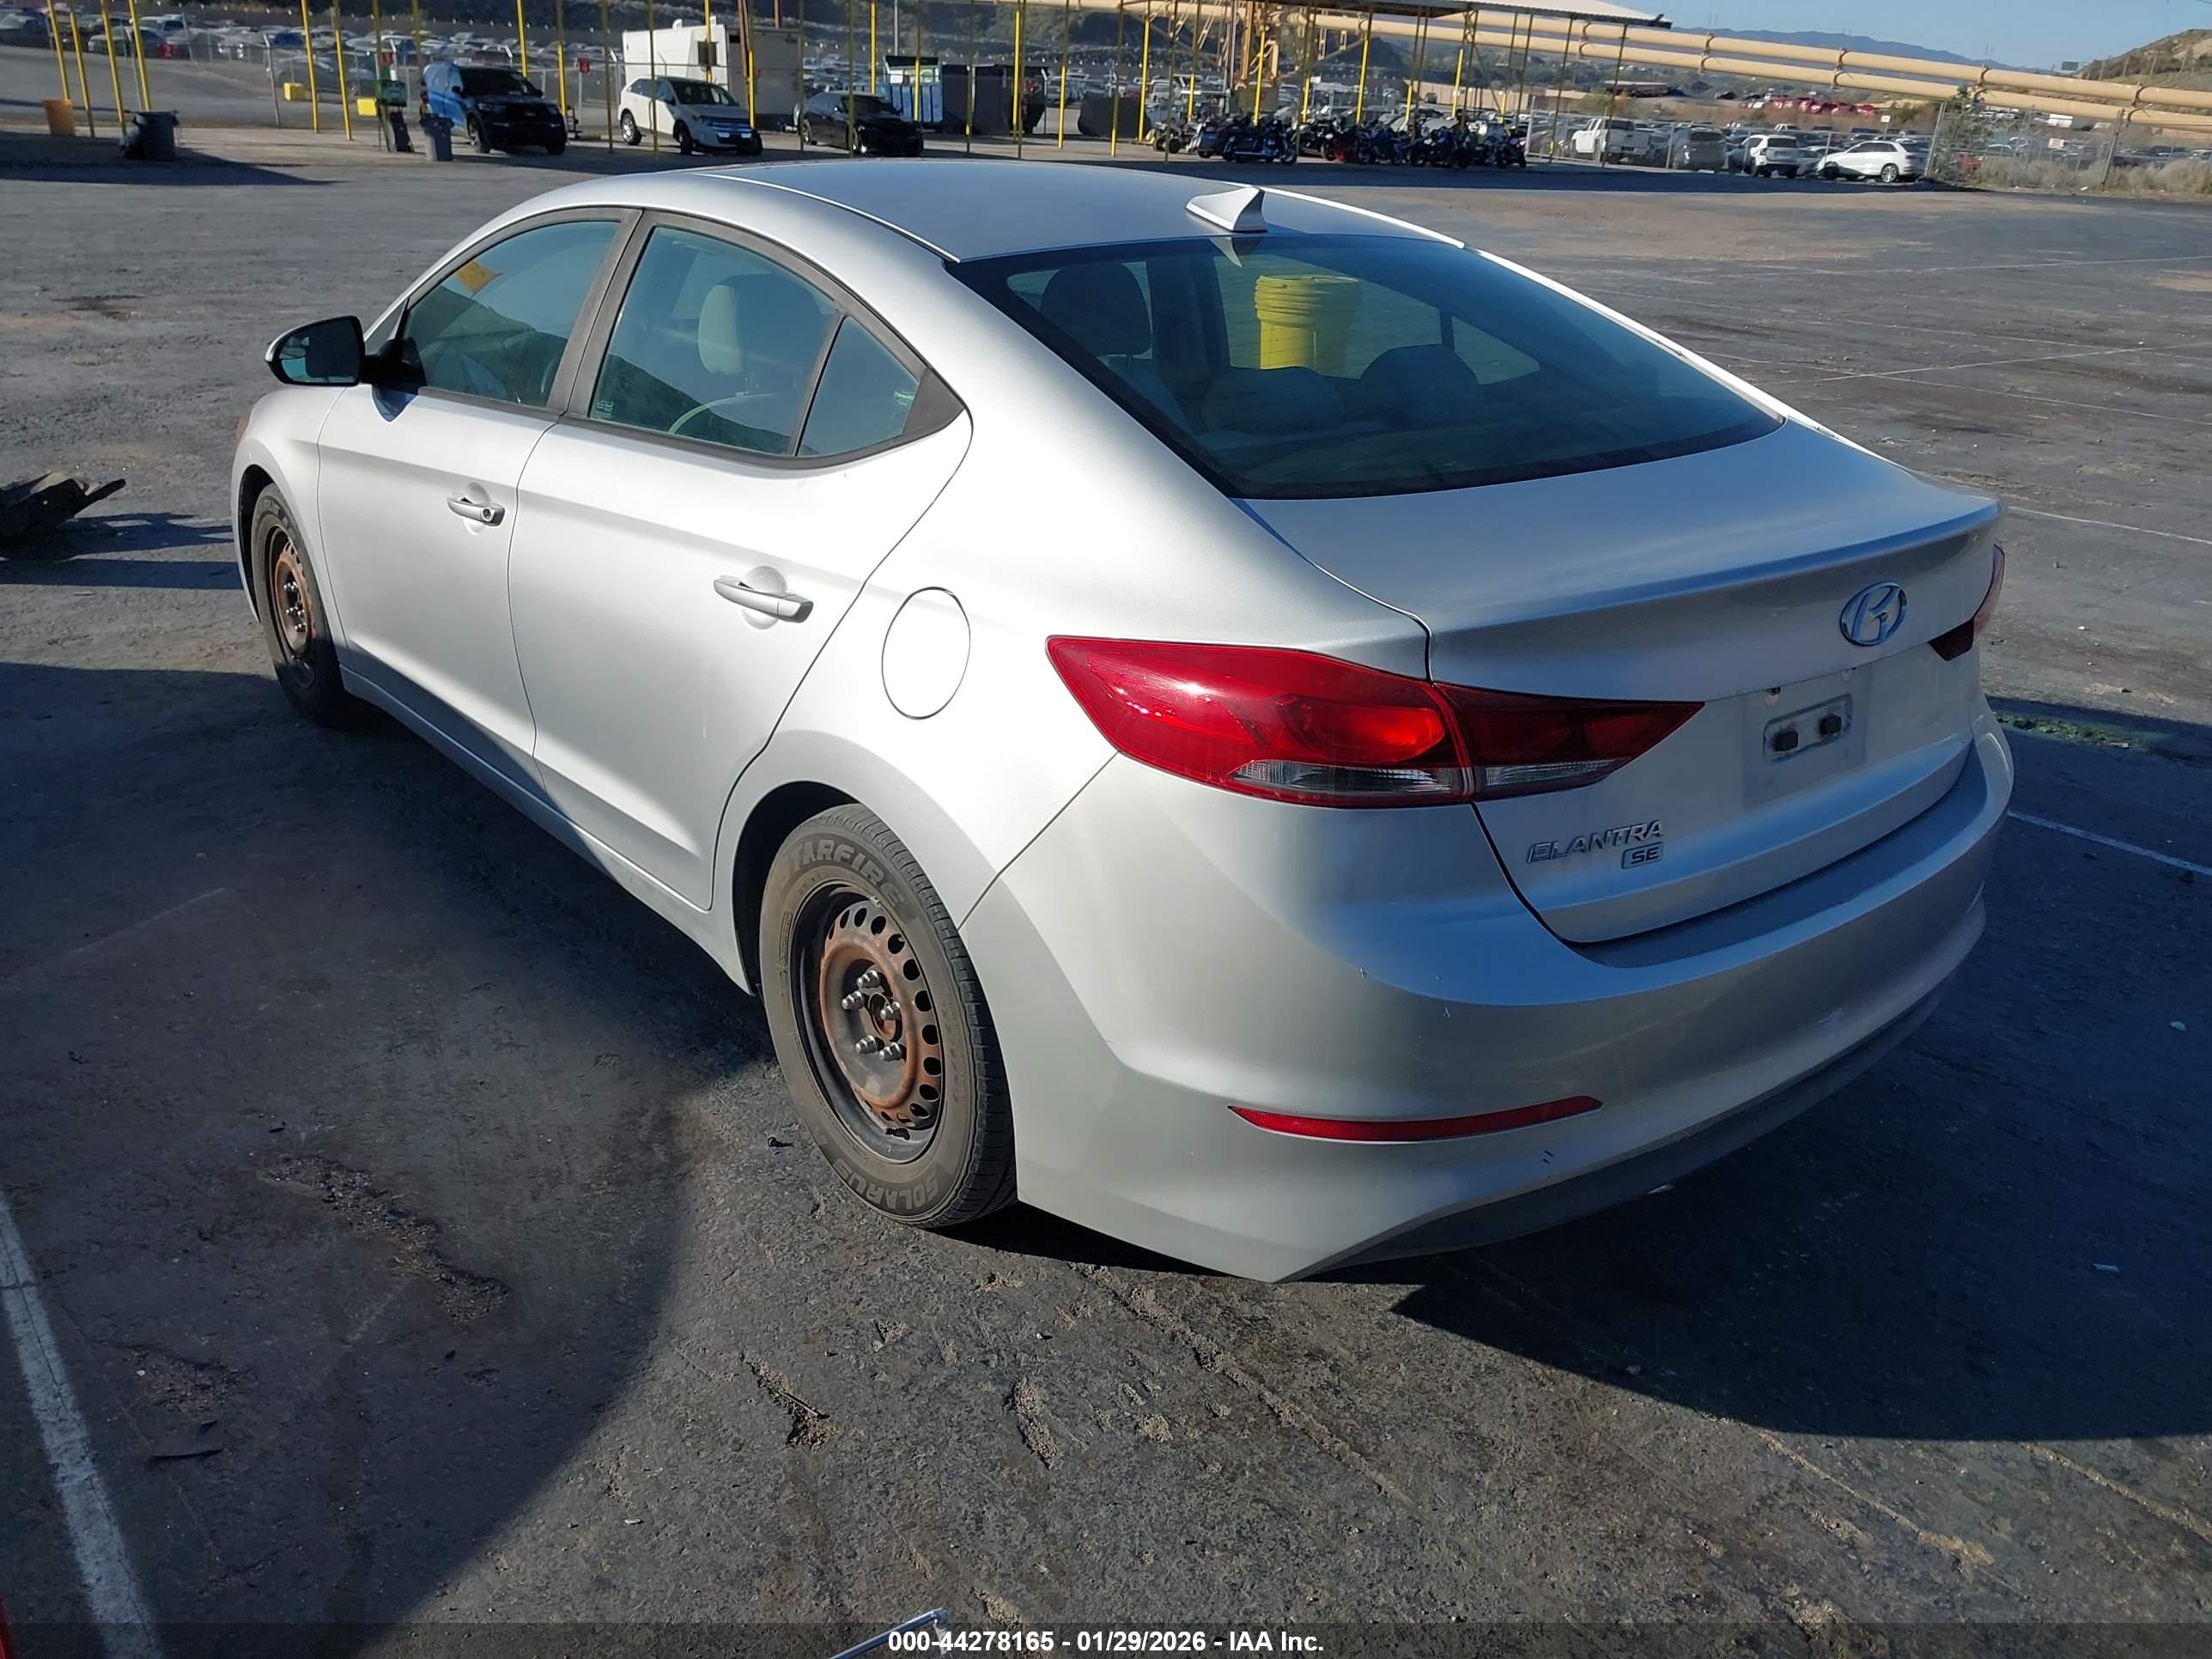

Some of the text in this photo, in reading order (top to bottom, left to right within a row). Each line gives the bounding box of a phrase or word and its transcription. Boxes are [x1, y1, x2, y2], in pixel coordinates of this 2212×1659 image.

[1526, 819, 1663, 866] ELANTRA
[1627, 845, 1662, 866] SE
[832, 1158, 939, 1210] SOLARUS
